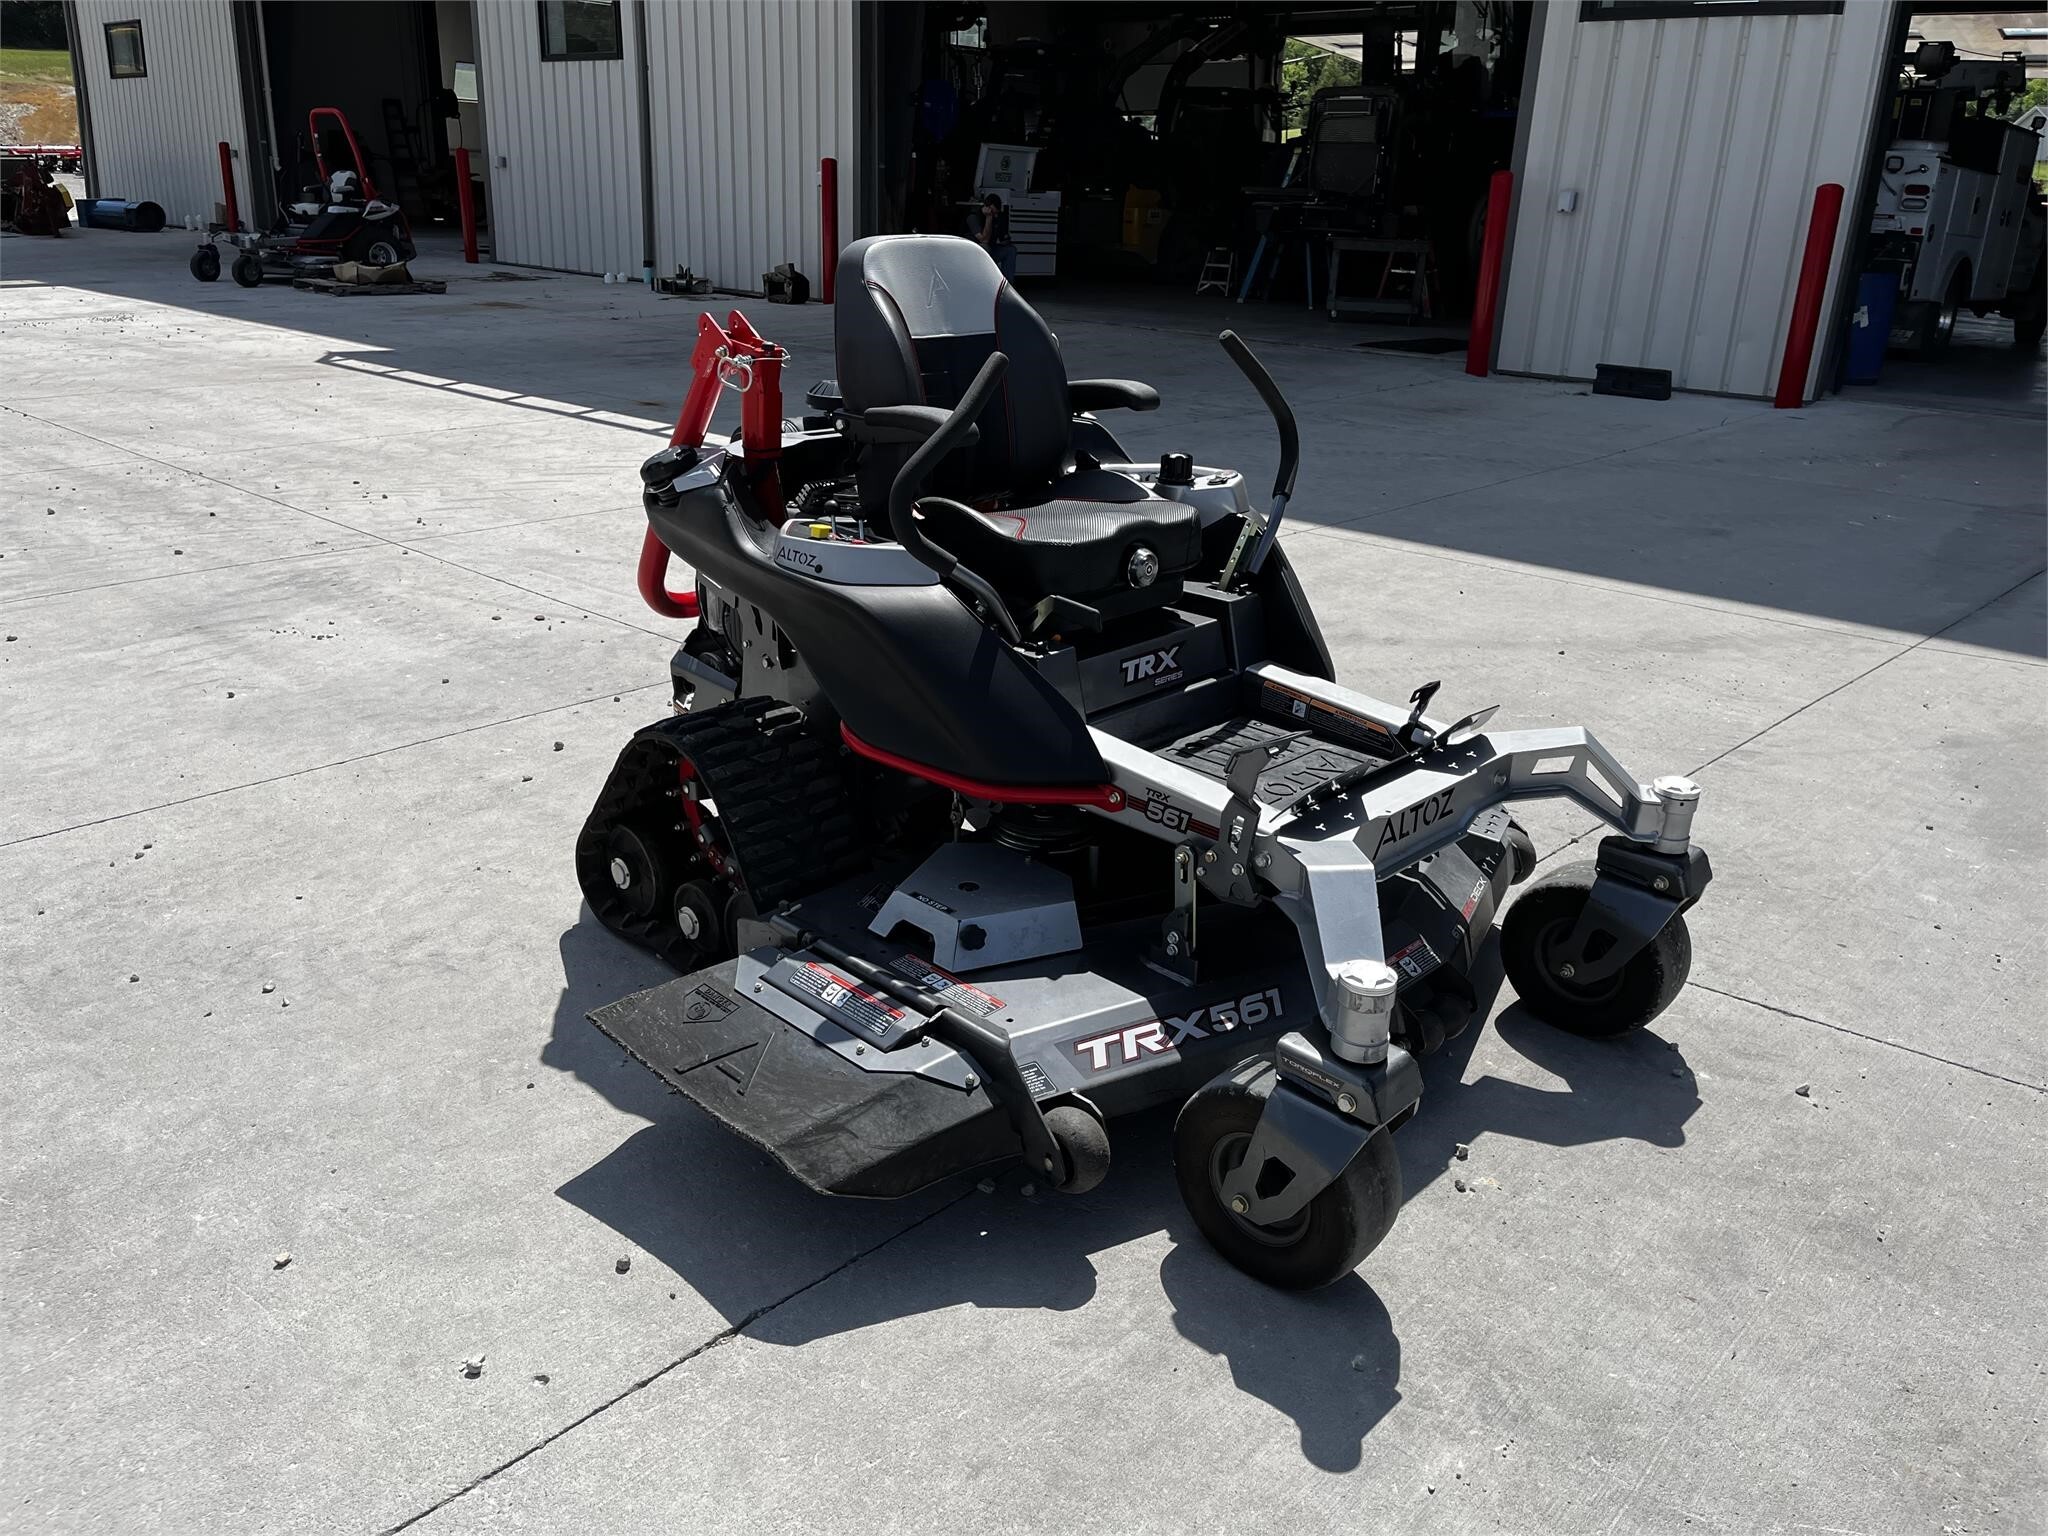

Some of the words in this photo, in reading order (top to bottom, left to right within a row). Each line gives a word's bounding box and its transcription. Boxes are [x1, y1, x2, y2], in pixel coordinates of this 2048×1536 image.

[776, 546, 817, 569] ALTOZ
[1122, 646, 1179, 683] TRX
[1154, 670, 1183, 686] SERIES
[1145, 787, 1171, 803] TRX
[1145, 798, 1192, 834] 561
[1372, 787, 1455, 861] ALTOZ
[917, 895, 930, 903] NO
[928, 900, 949, 911] STEP
[1075, 987, 1285, 1072] TRX561
[1281, 1056, 1341, 1089] TORQFLEX
